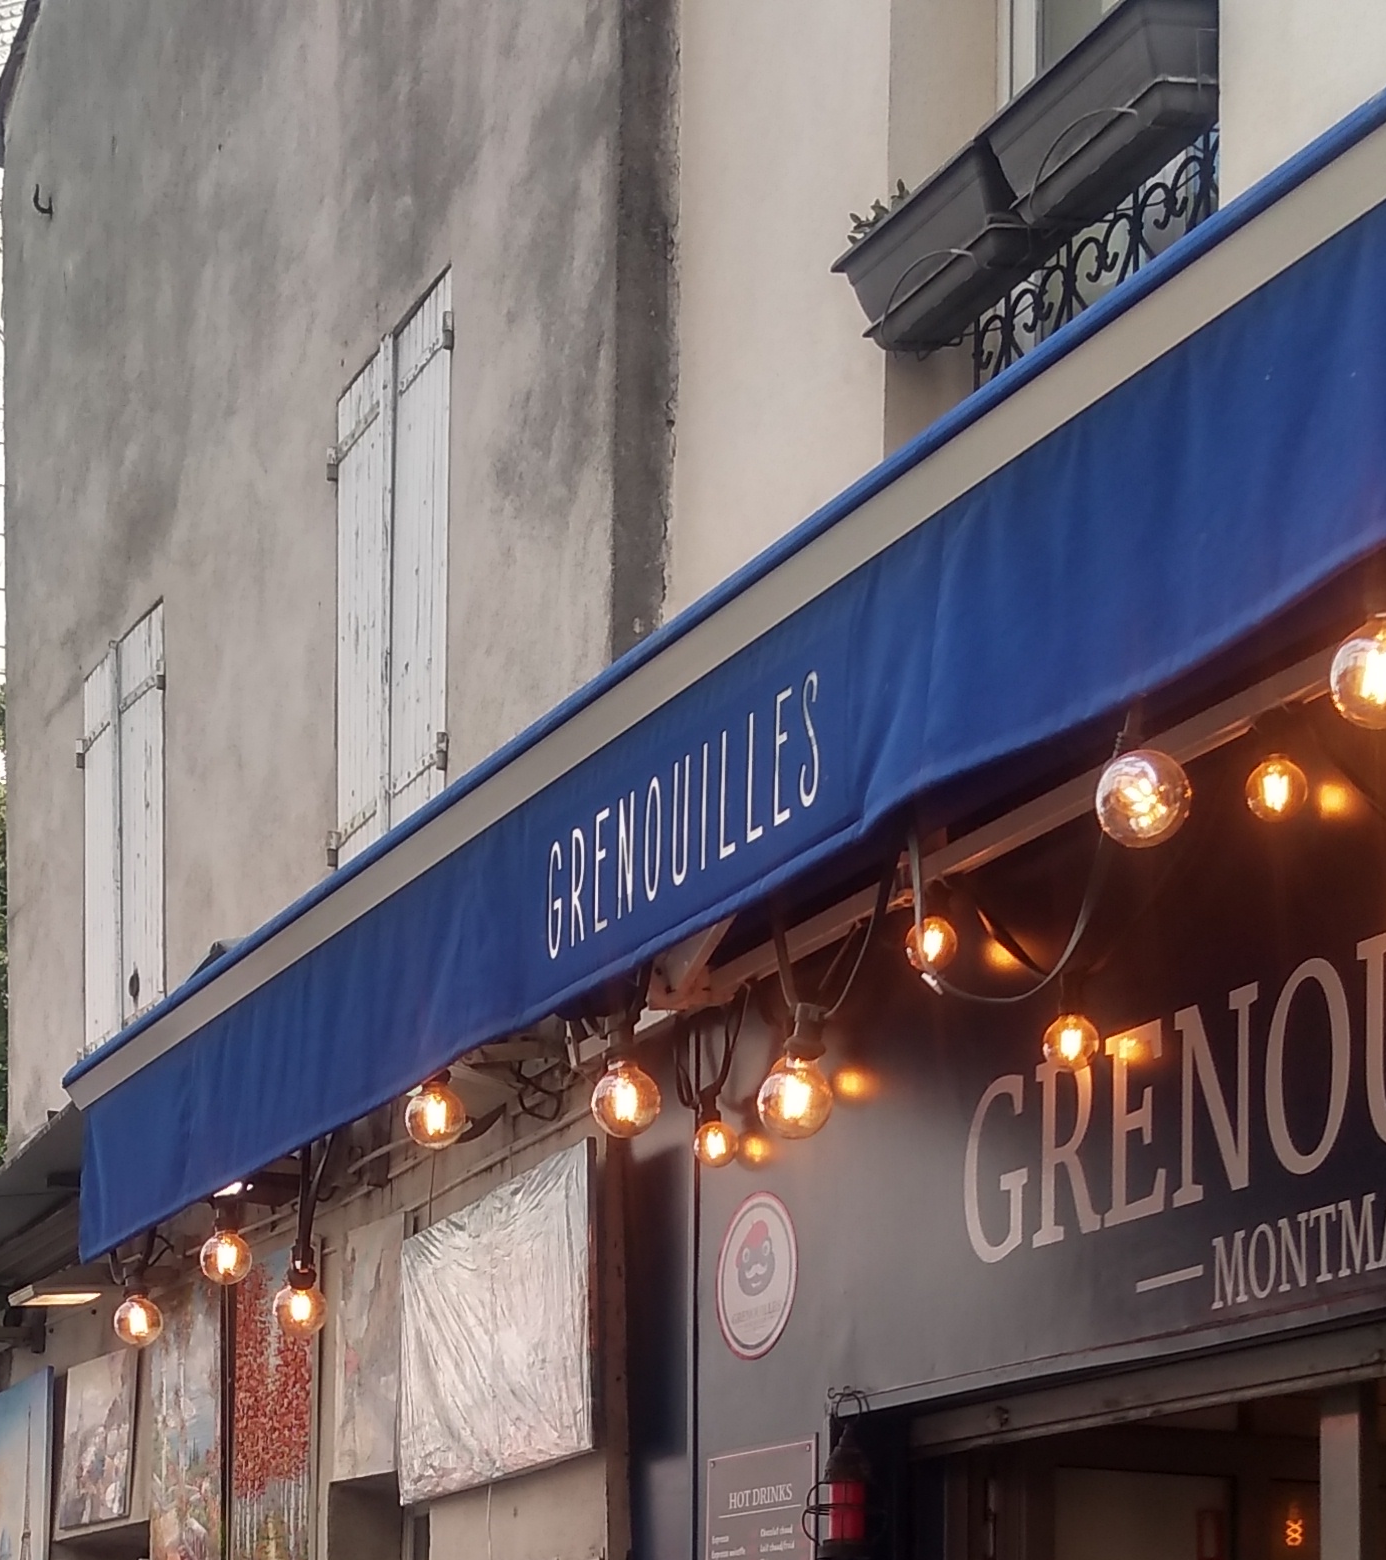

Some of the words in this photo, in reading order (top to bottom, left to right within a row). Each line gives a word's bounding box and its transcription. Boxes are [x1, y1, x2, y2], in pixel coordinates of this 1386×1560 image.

[547, 671, 820, 960] GRENOUILLES
[729, 1490, 751, 1510] HOT
[752, 1483, 793, 1507] DRINKS
